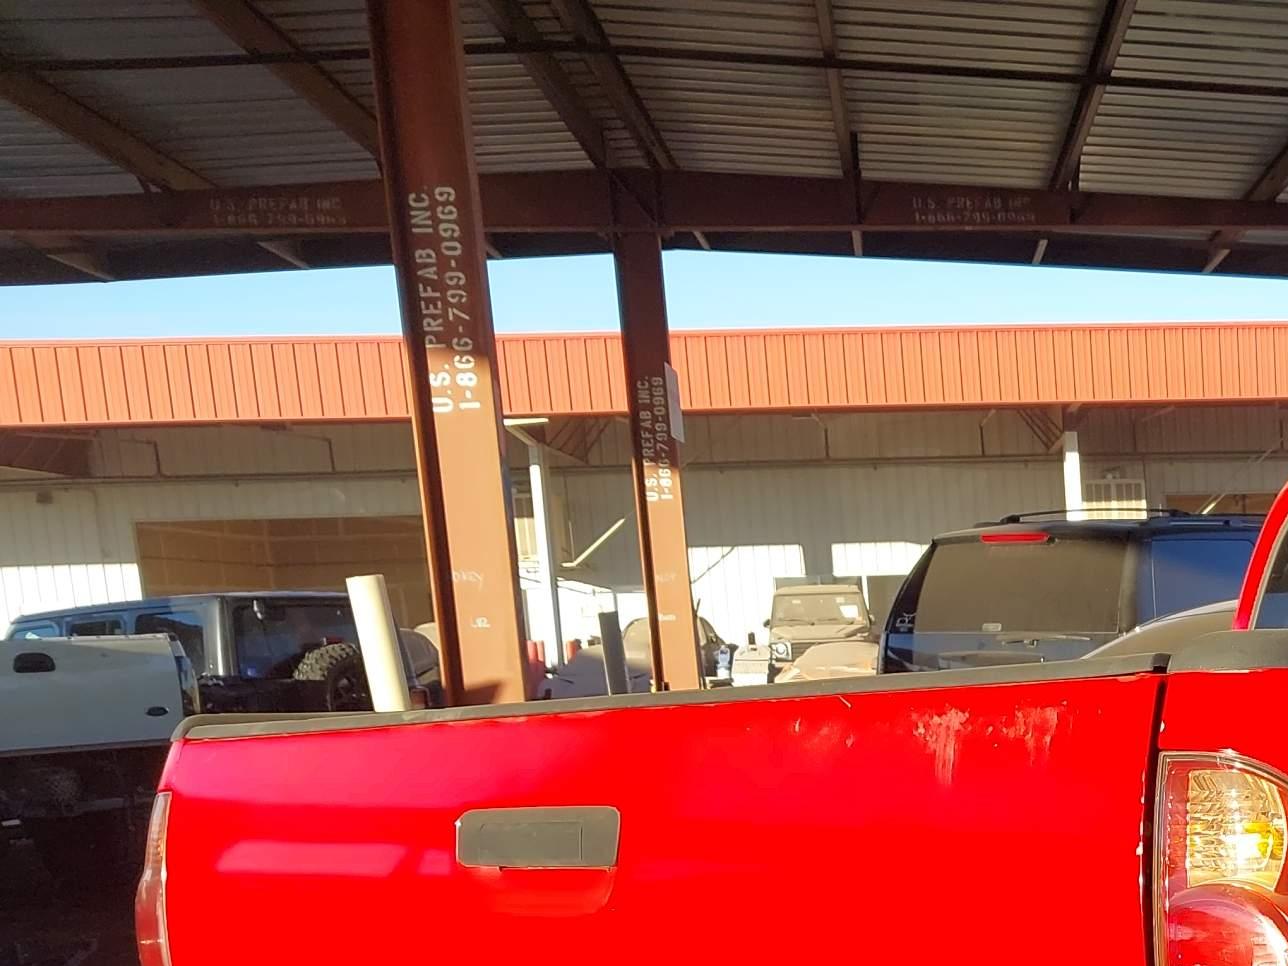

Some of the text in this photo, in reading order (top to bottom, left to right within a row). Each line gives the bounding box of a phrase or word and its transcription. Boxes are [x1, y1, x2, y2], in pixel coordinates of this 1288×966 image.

[415, 248, 447, 350] PREFAB
[434, 186, 481, 410] 1-866-799-0969
[430, 363, 454, 413] U.S.
[640, 411, 656, 466] PREFAB
